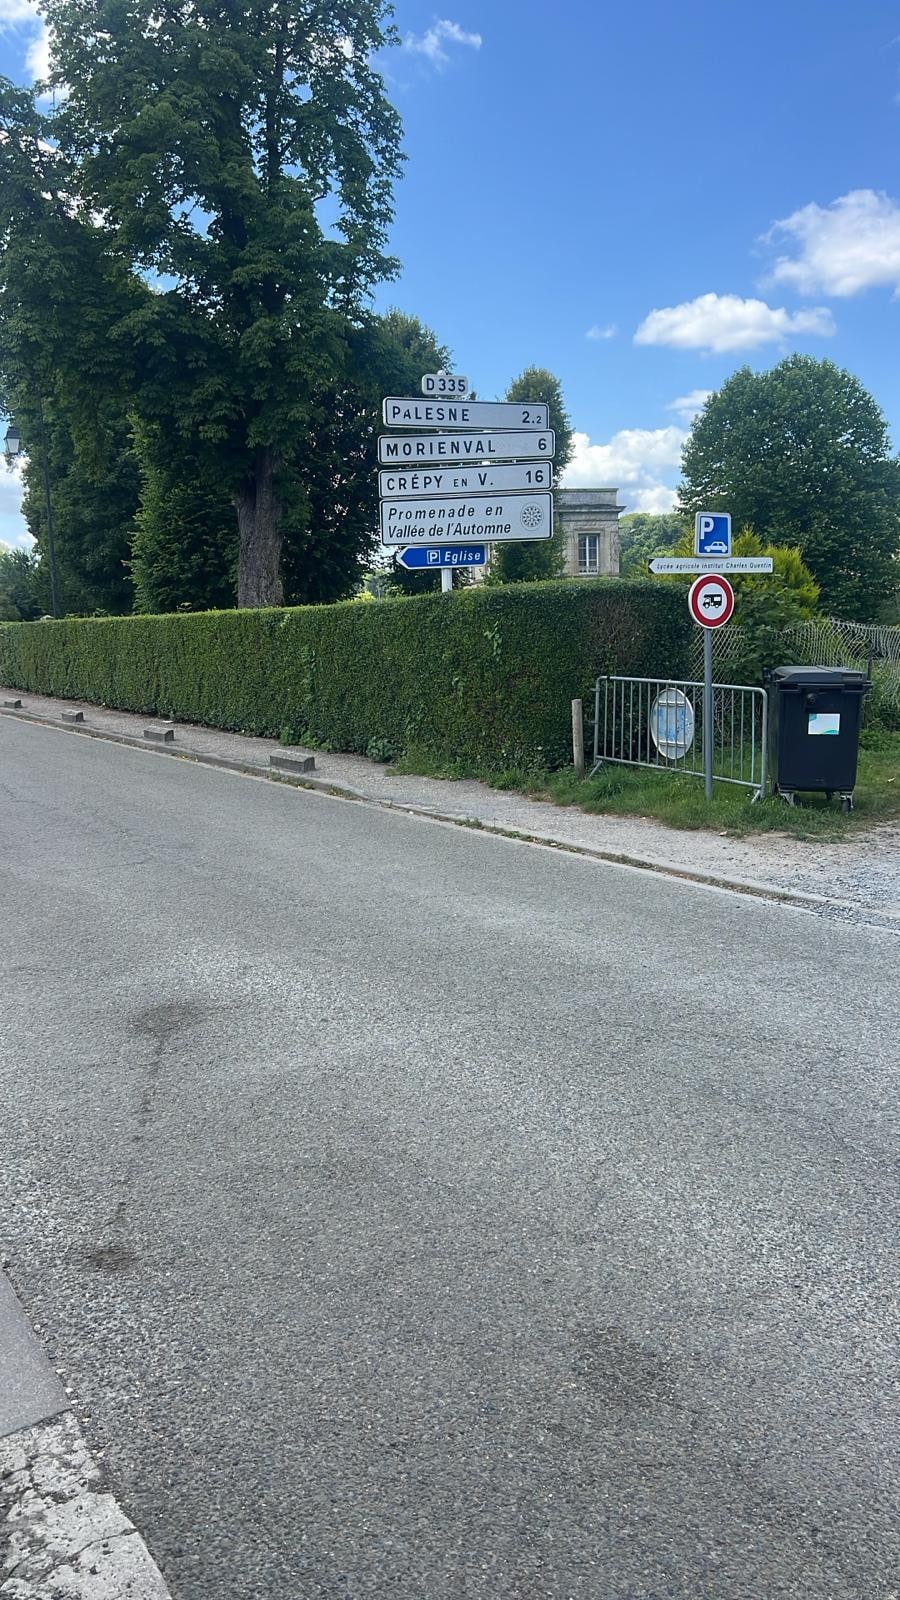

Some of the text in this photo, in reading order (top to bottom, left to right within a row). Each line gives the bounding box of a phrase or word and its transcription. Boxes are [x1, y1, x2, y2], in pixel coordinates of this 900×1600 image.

[392, 406, 542, 424] PALESNE 2.2
[386, 438, 547, 457] MORIENVAL 6
[387, 470, 543, 490] CRÉPY EN V. 16
[388, 505, 503, 520] Promenade en
[388, 522, 511, 538] Vallée de l'Automne
[700, 518, 714, 539] P
[445, 551, 481, 562] Eglise
